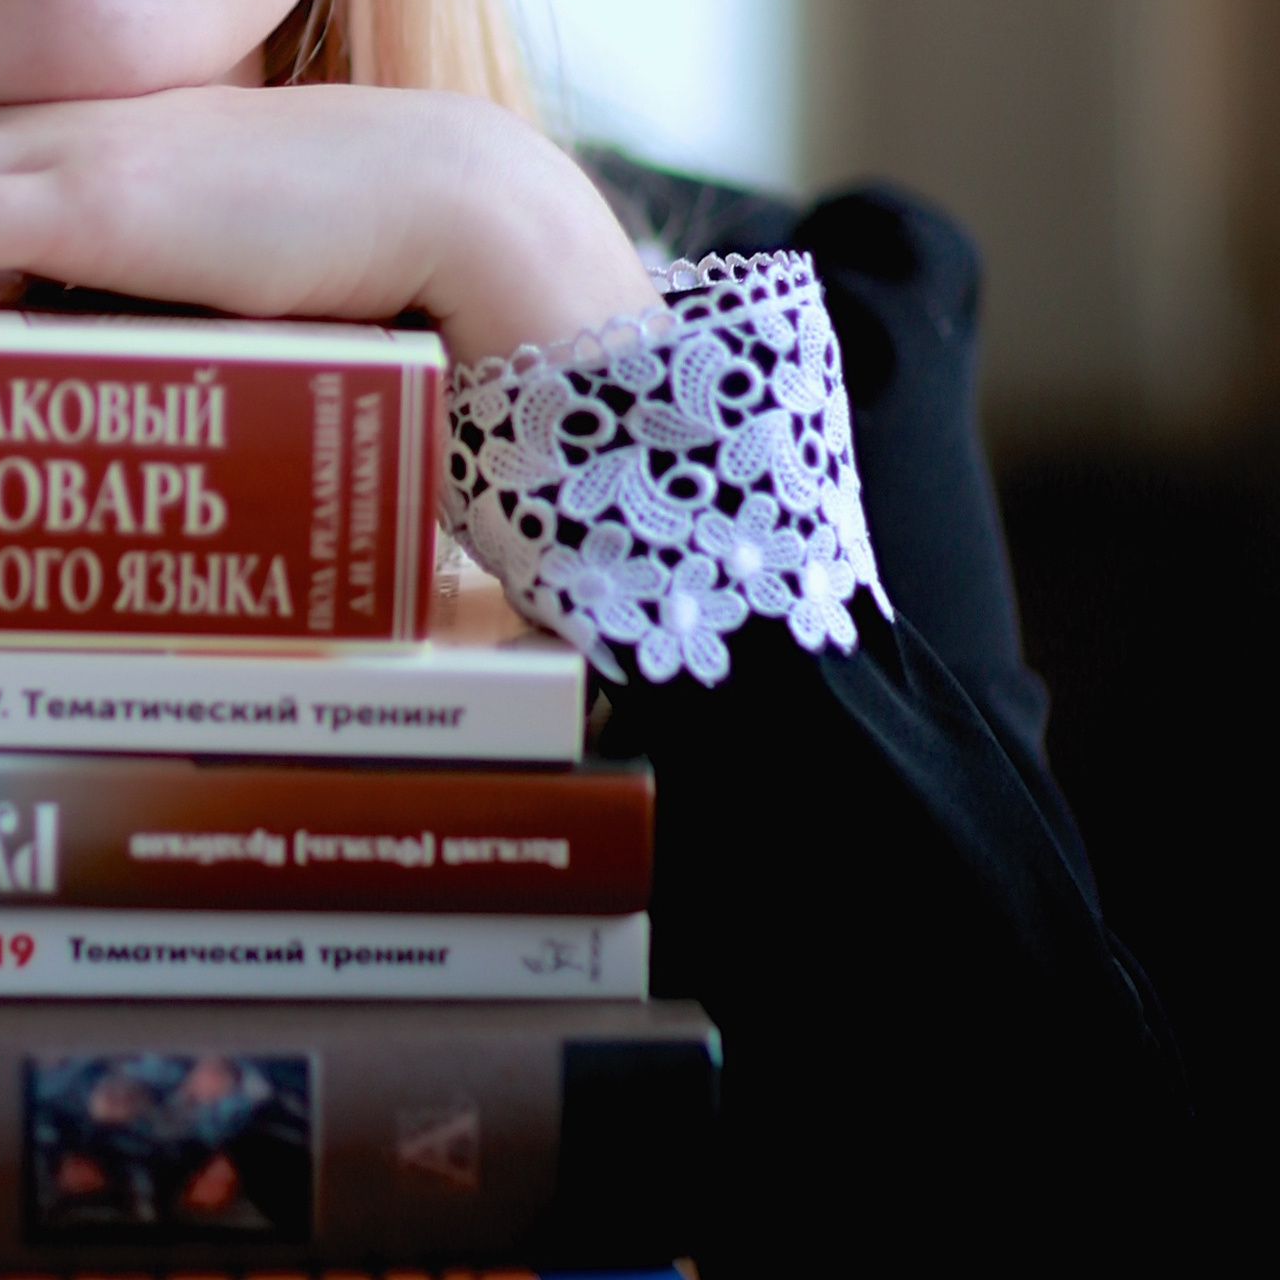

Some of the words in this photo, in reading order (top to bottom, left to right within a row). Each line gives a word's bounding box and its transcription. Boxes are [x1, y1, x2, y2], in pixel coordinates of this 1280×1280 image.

[113, 549, 294, 617] ЯЗЫКА
[308, 566, 336, 630] ПОД
[23, 689, 298, 725] Тематический
[311, 700, 466, 732] тренинг
[68, 936, 304, 966] Тематический
[318, 942, 450, 968] тренинг
